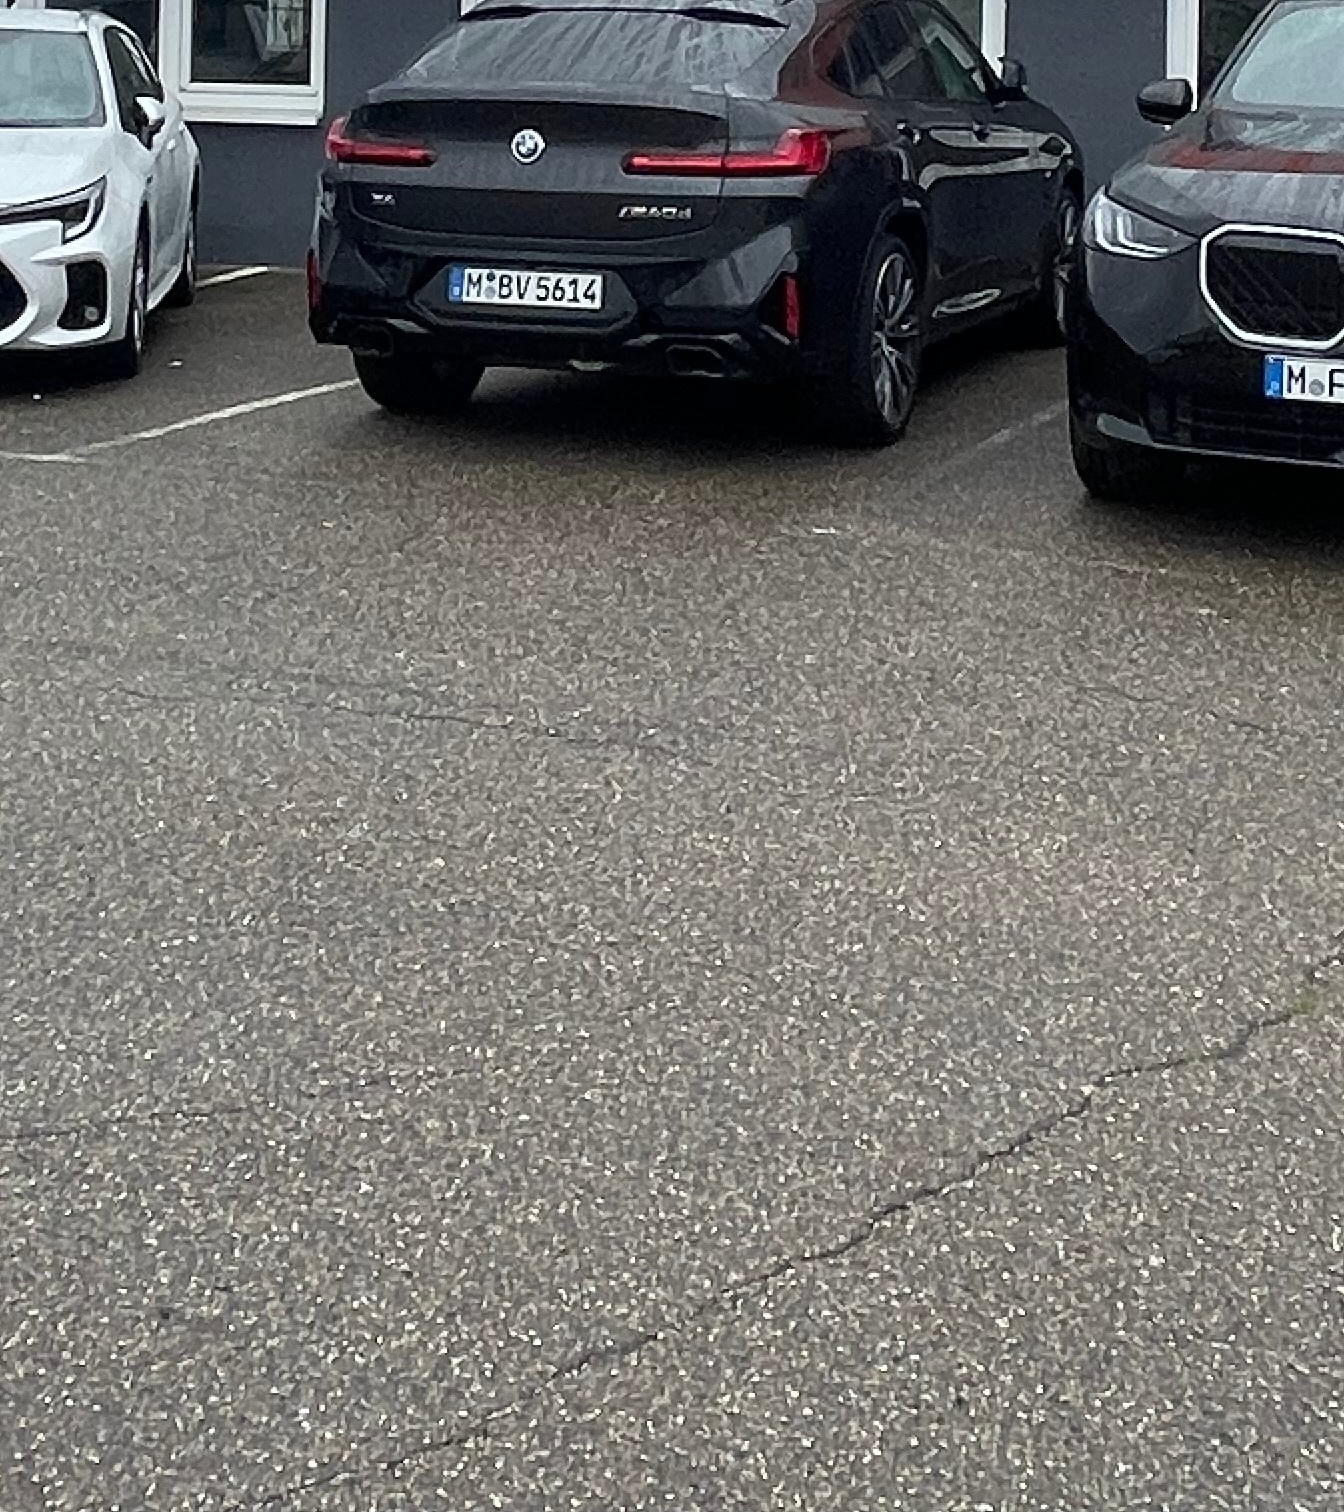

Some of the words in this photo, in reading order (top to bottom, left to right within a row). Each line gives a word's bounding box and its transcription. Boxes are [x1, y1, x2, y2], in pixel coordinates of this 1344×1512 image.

[466, 272, 483, 298] M
[498, 274, 532, 300] BV
[536, 276, 597, 304] 5614
[1286, 364, 1307, 394] M
